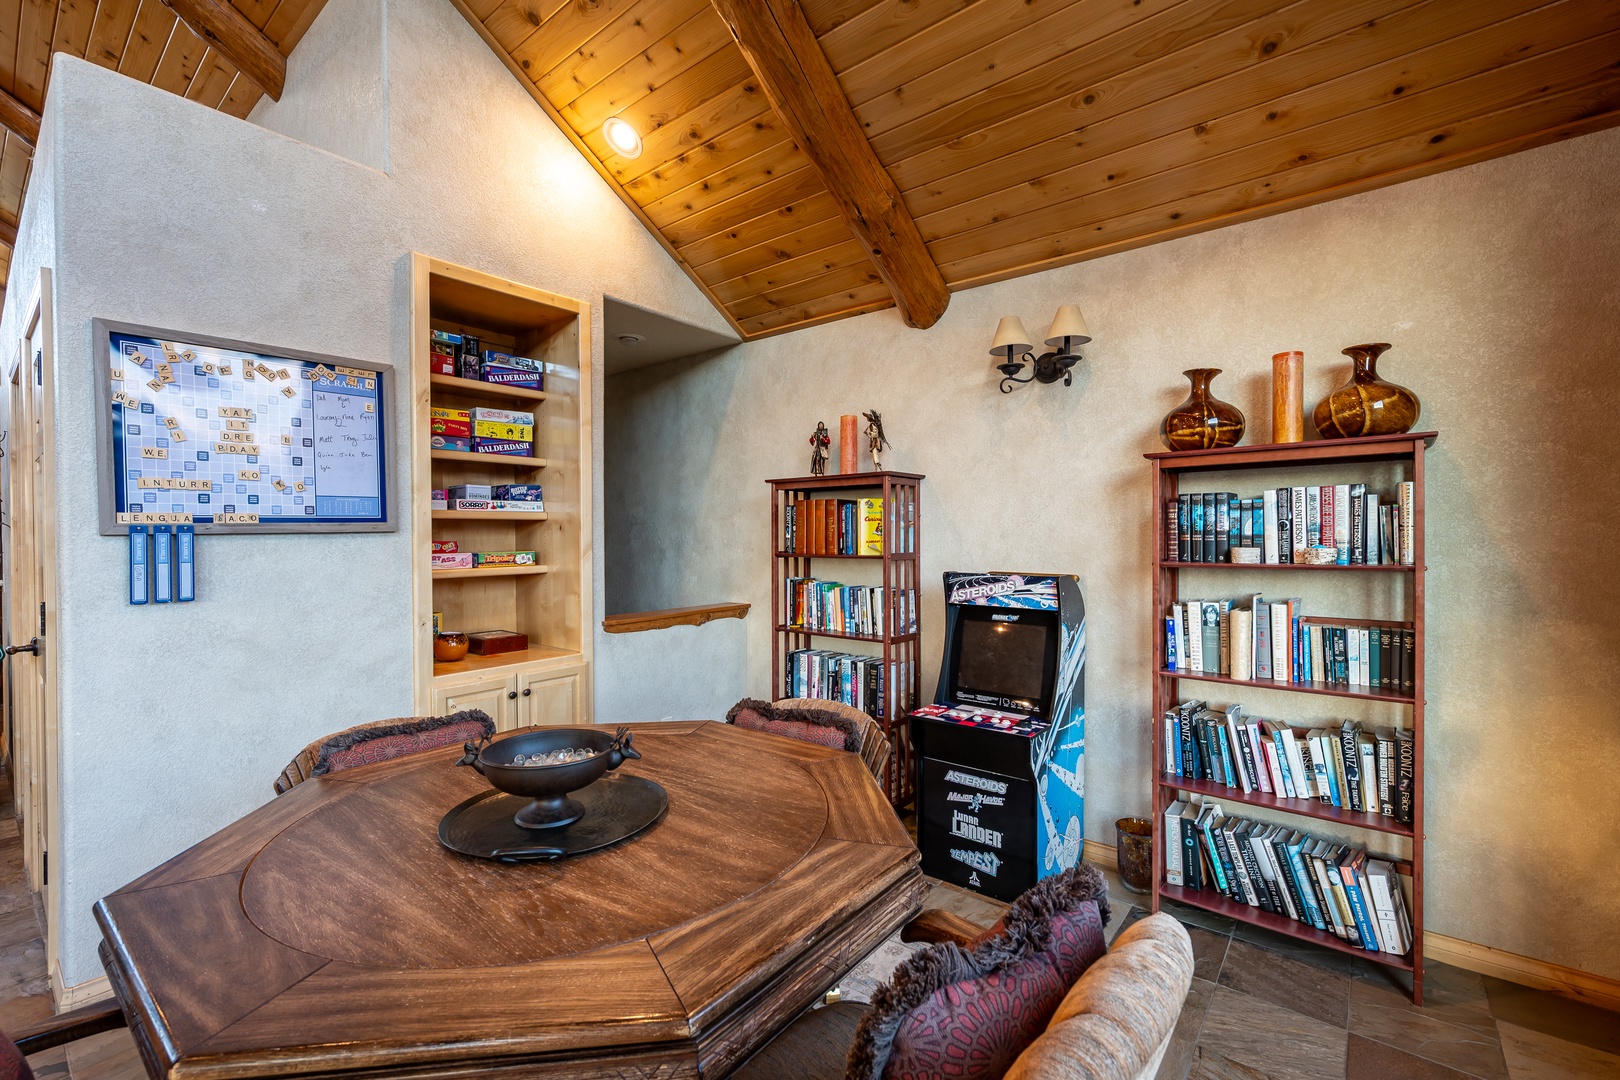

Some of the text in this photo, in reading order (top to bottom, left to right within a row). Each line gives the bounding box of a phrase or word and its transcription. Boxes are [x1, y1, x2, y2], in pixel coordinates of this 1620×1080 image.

[488, 373, 540, 382] BALDERDASH
[222, 408, 251, 417] YAY
[478, 442, 530, 453] BALDERDASH
[460, 501, 487, 509] SORRY!
[1294, 489, 1303, 544] JAMES PATTERSON
[121, 514, 191, 523] LENGUA
[1353, 498, 1361, 548] JAMES PATTERSON
[950, 581, 1015, 601] ASTEROIDS
[1181, 709, 1191, 741] KOONTZ
[1343, 733, 1357, 768] KOONTZ
[1379, 741, 1388, 758] POWER
[944, 770, 1008, 795] ASTEROIDS
[1400, 741, 1412, 811] KOONTZ Face
[1380, 778, 1389, 802] STRATEGY
[953, 809, 979, 826] LUNAR
[951, 816, 1003, 849] LANDER
[1171, 820, 1180, 869] MERCK MANUAL
[950, 848, 1001, 878] TEMPEST
[1231, 852, 1243, 870] TEMPLAR
[1241, 850, 1257, 880] TIMELINE
[1244, 840, 1265, 889] MICHAEL CRICHTON
[1276, 845, 1303, 917] THOMAS HARRIS HANNIBAL
[1355, 904, 1365, 921] PATROL
